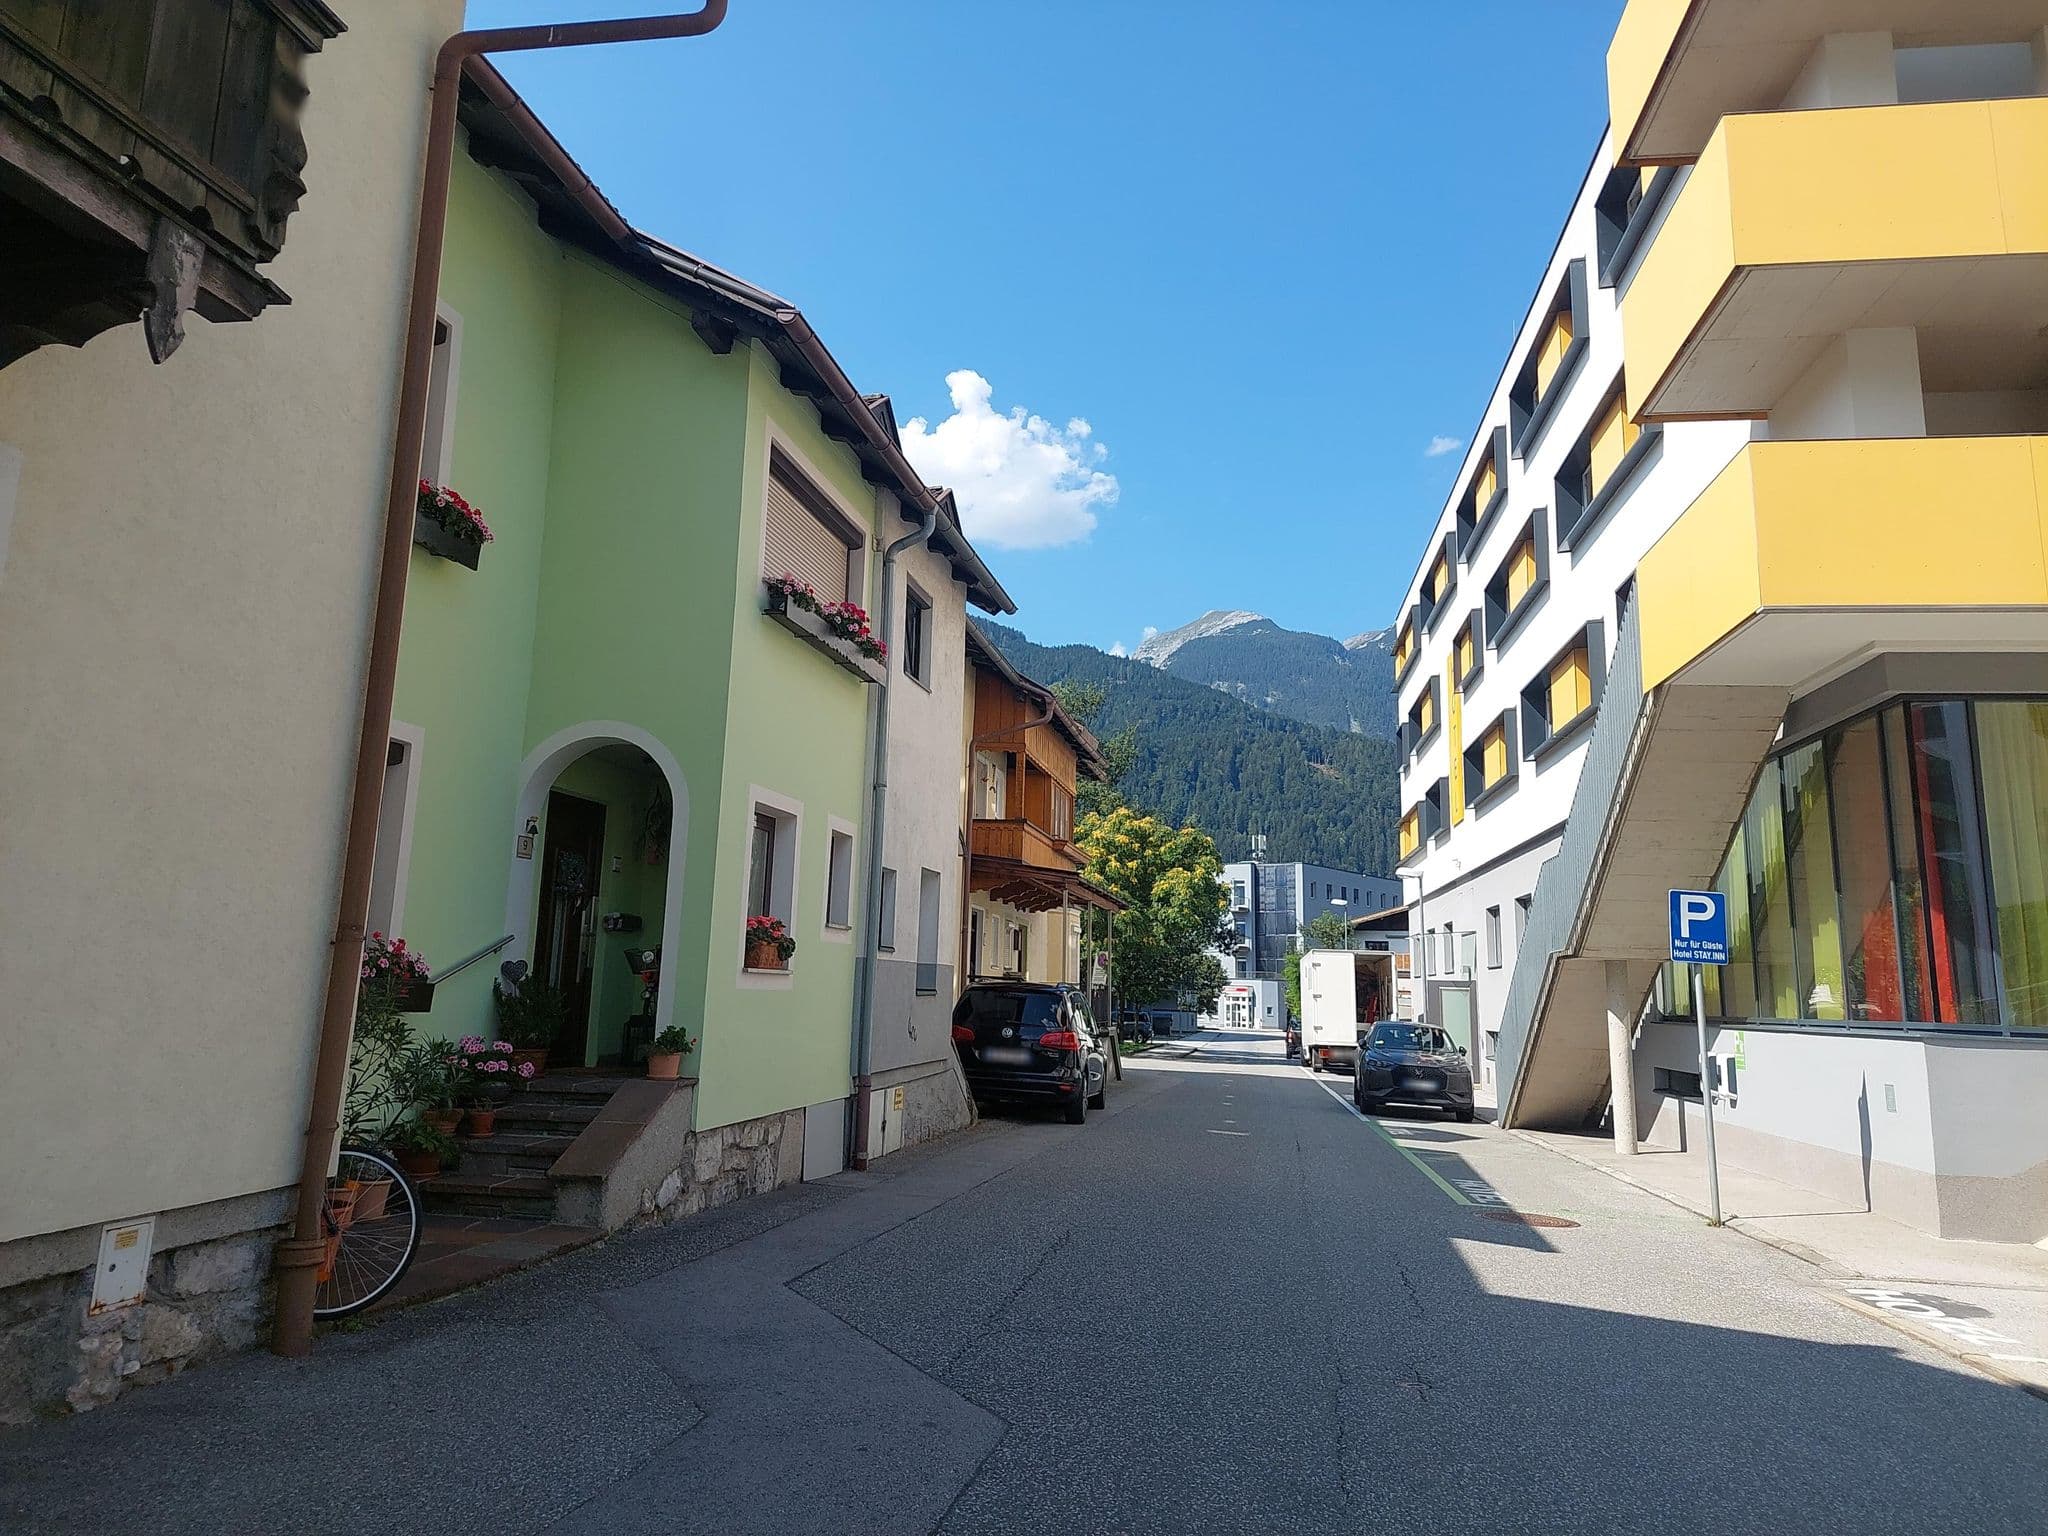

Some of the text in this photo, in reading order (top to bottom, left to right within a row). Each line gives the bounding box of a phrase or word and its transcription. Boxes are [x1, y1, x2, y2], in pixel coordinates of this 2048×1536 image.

[1680, 894, 1715, 938] P
[1674, 939, 1723, 950] Nur für Gäste
[1673, 949, 1726, 961] Hotel STAY.INN
